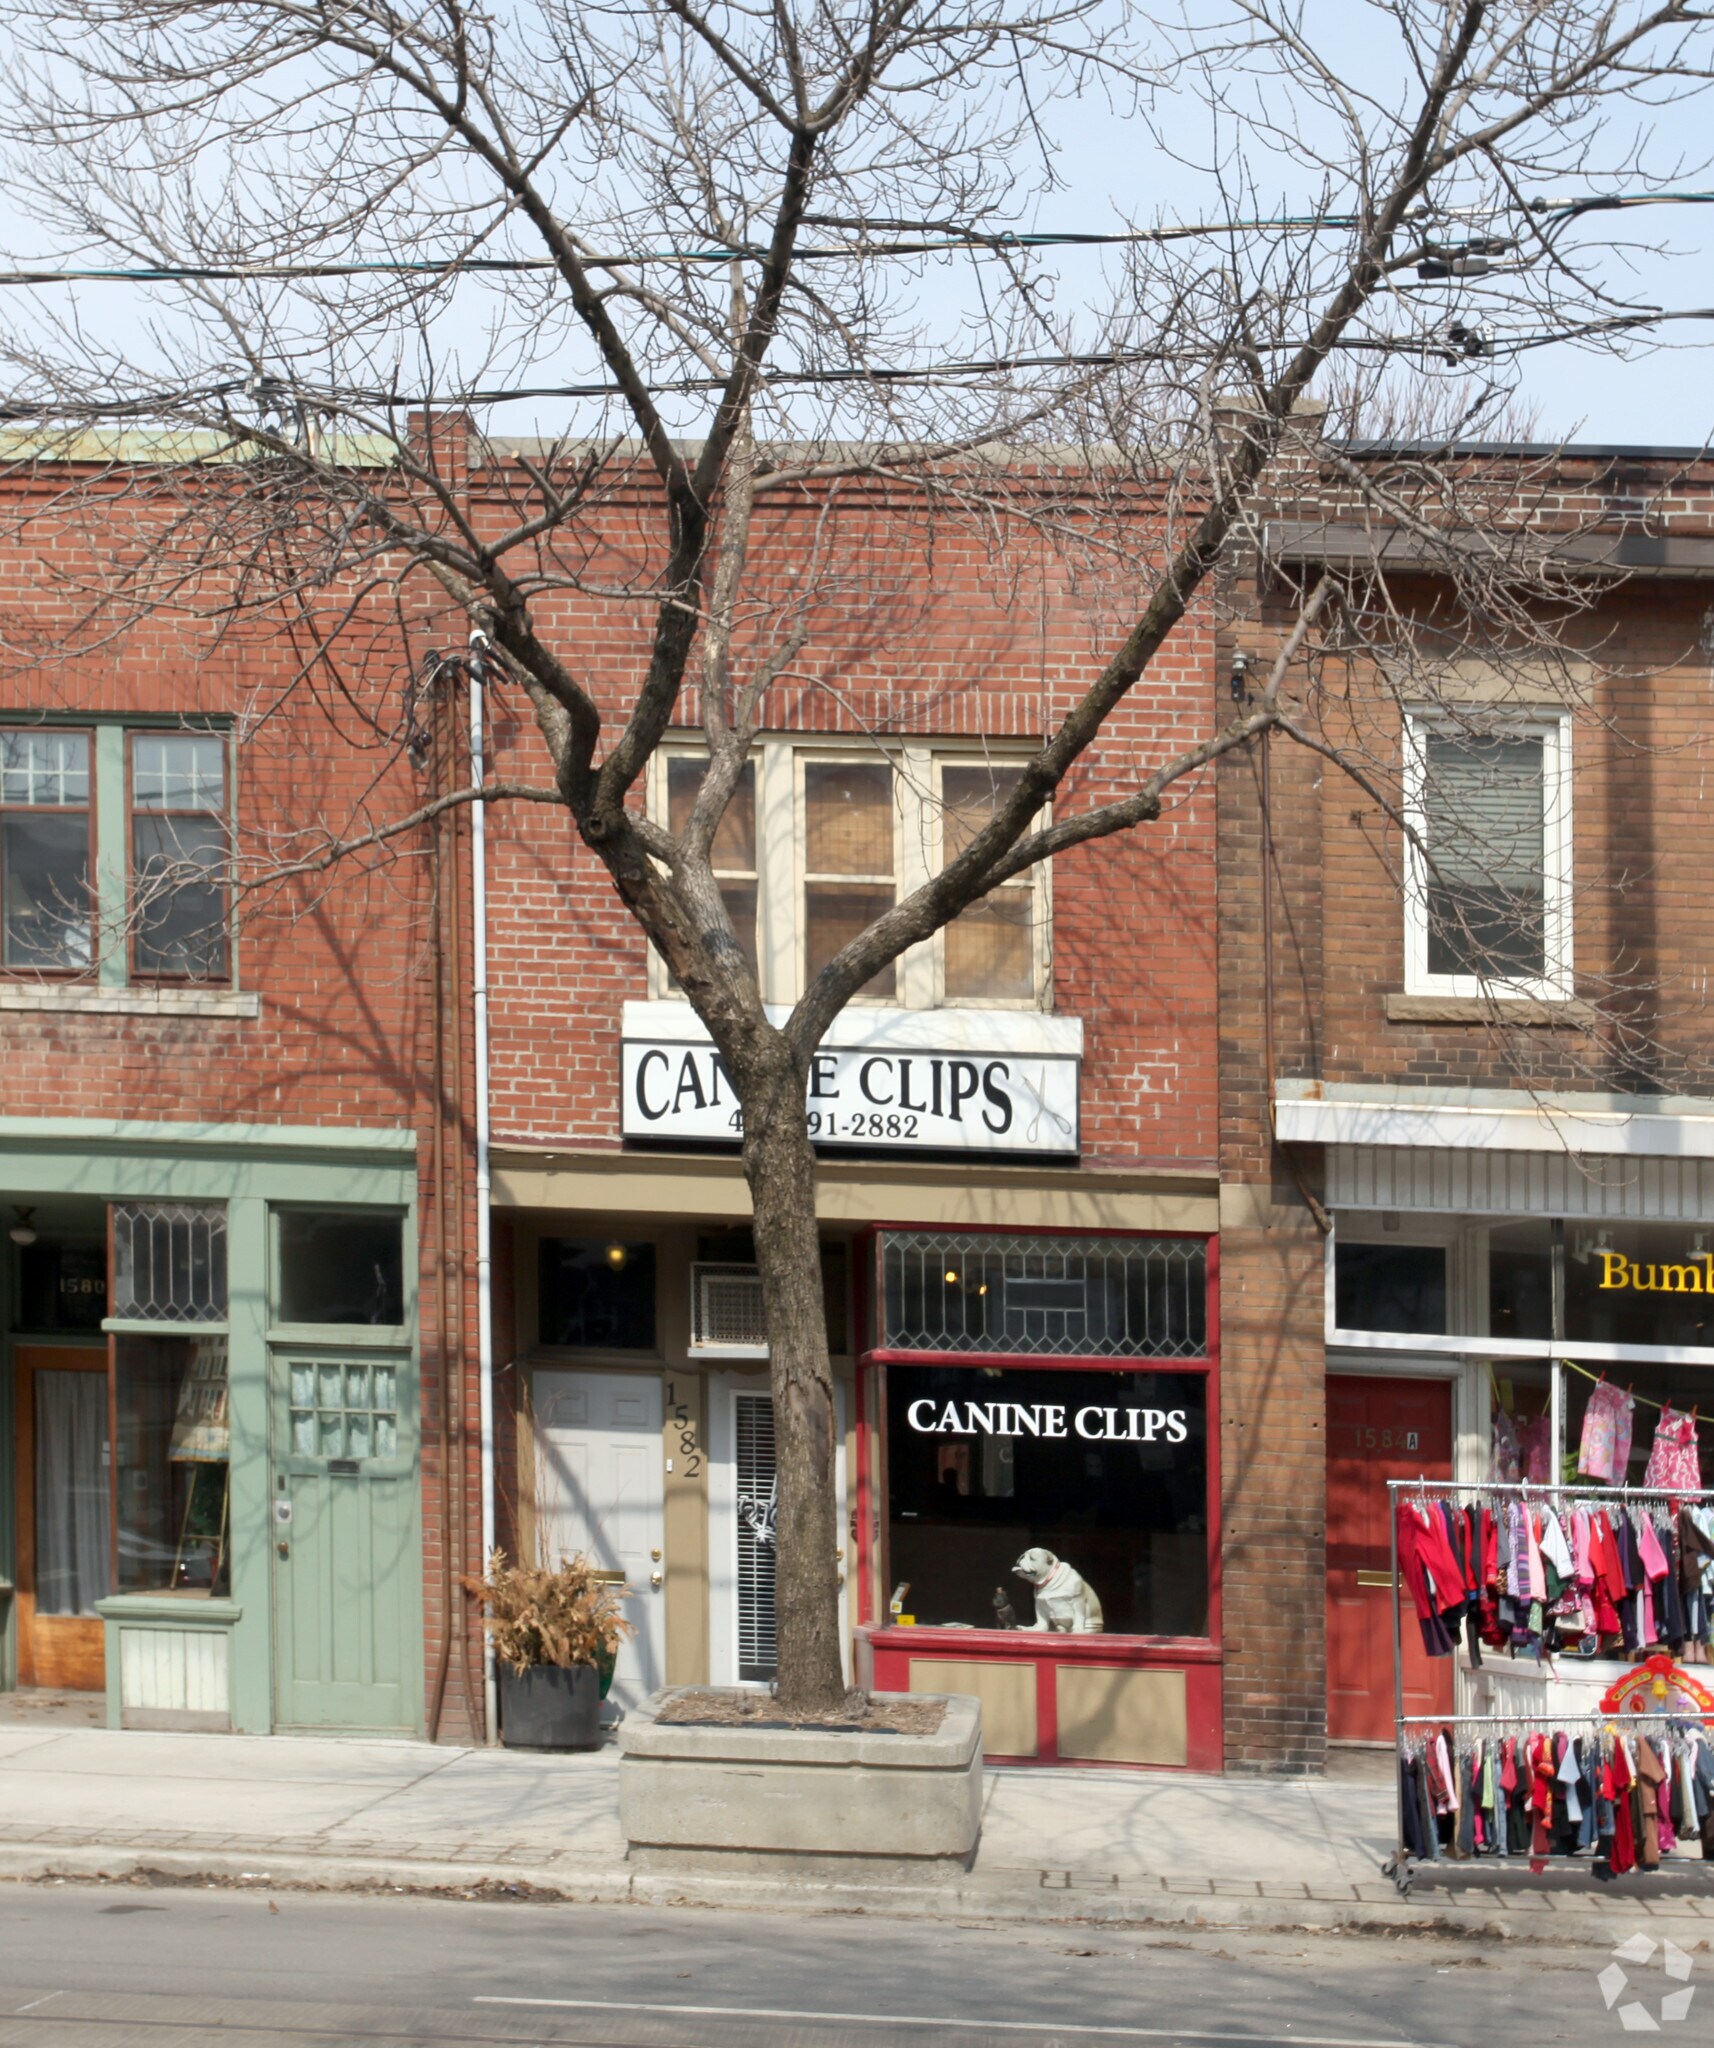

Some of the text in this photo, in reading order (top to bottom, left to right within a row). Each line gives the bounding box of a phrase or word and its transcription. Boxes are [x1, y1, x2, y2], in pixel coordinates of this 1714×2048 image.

[636, 1049, 1013, 1135] CANE CLIPS
[728, 1108, 919, 1139] 491-2882
[666, 1382, 701, 1478] 1582
[907, 1399, 1188, 1443] CANINE CLIPS
